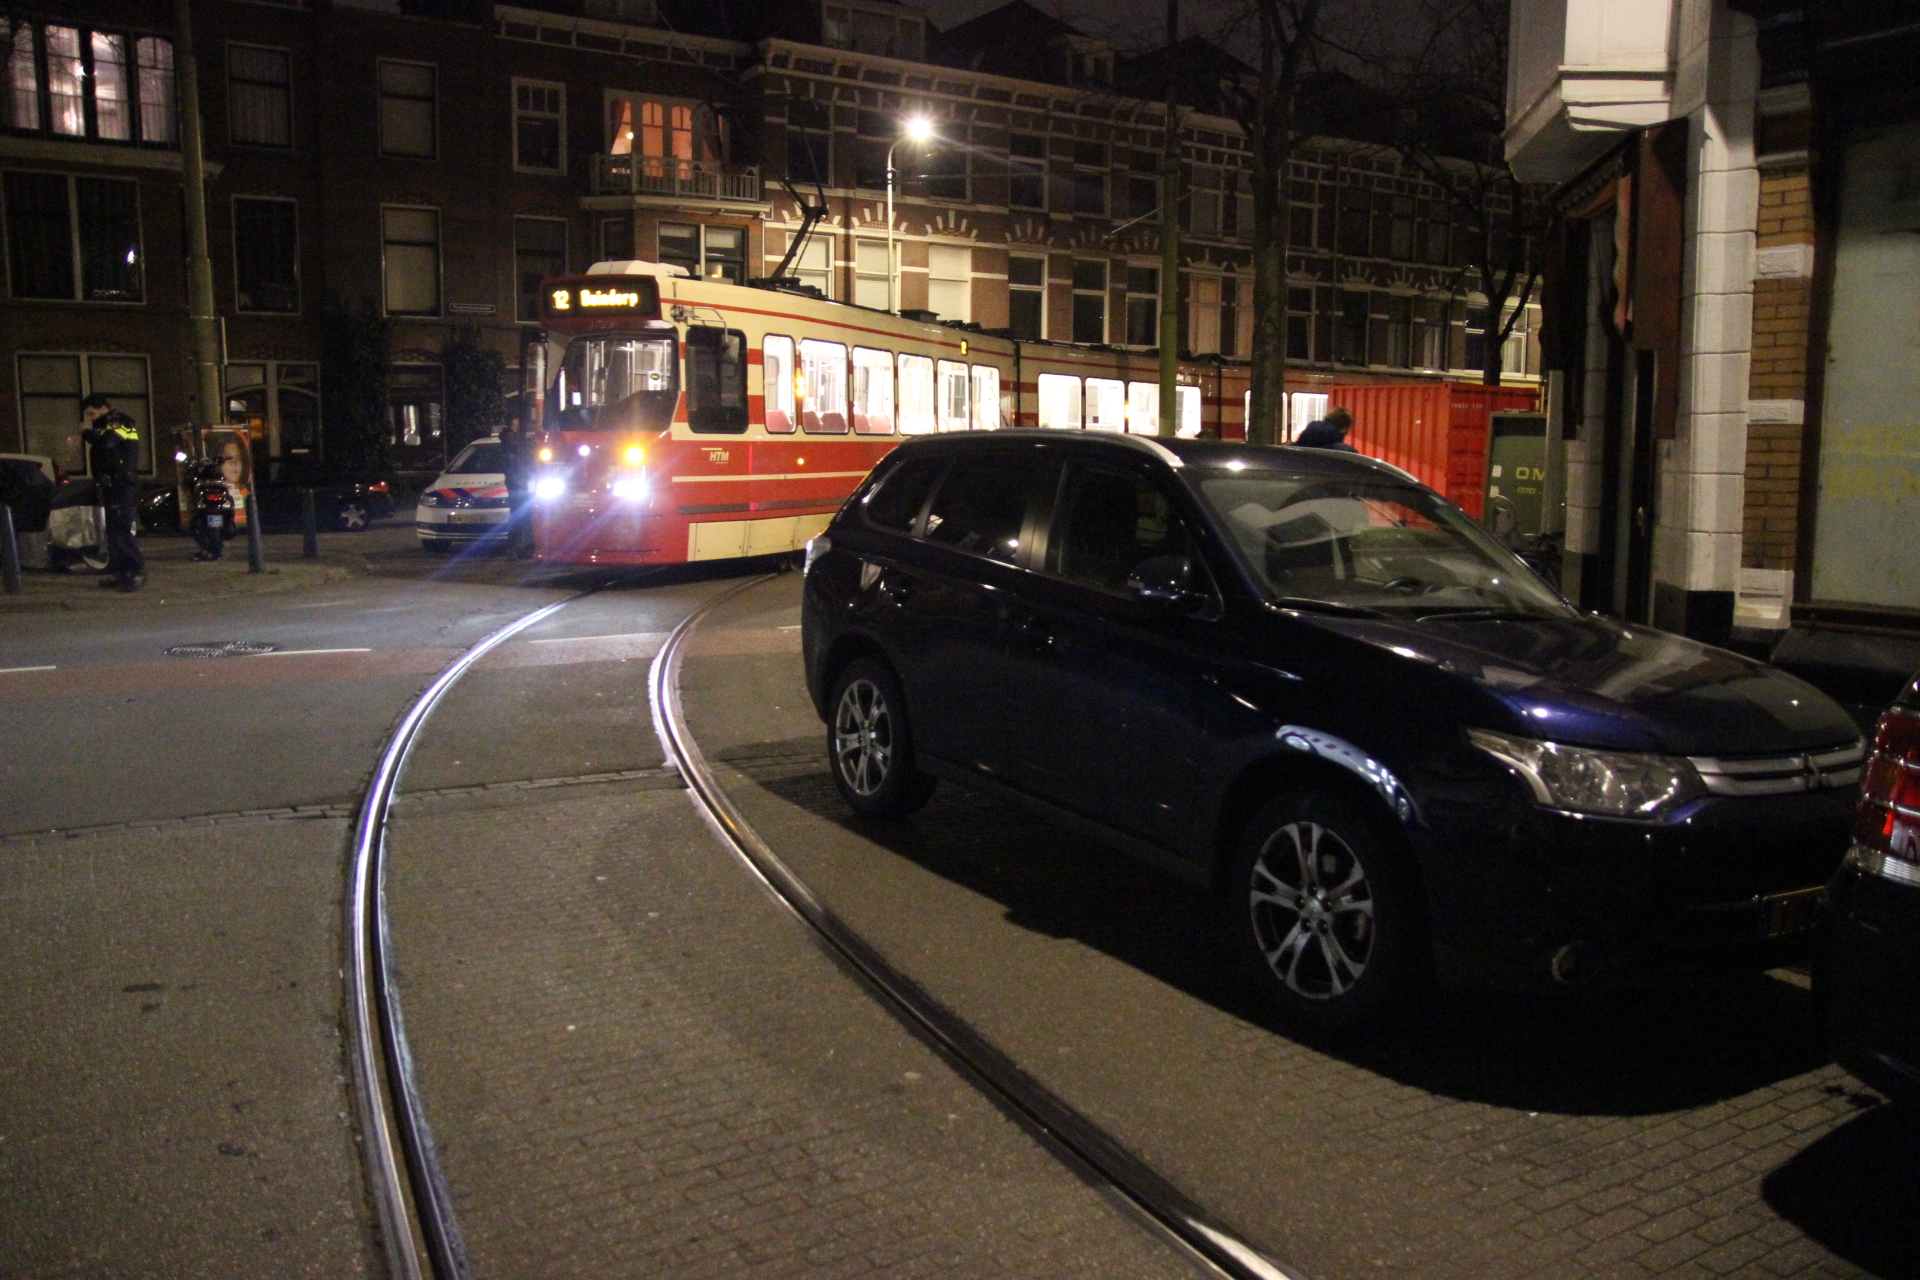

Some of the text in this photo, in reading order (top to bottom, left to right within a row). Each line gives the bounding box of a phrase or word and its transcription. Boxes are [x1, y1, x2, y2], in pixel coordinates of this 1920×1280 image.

[552, 289, 639, 310] 12 Duindorp
[1832, 424, 1920, 458] VER
[709, 451, 730, 462] HTM
